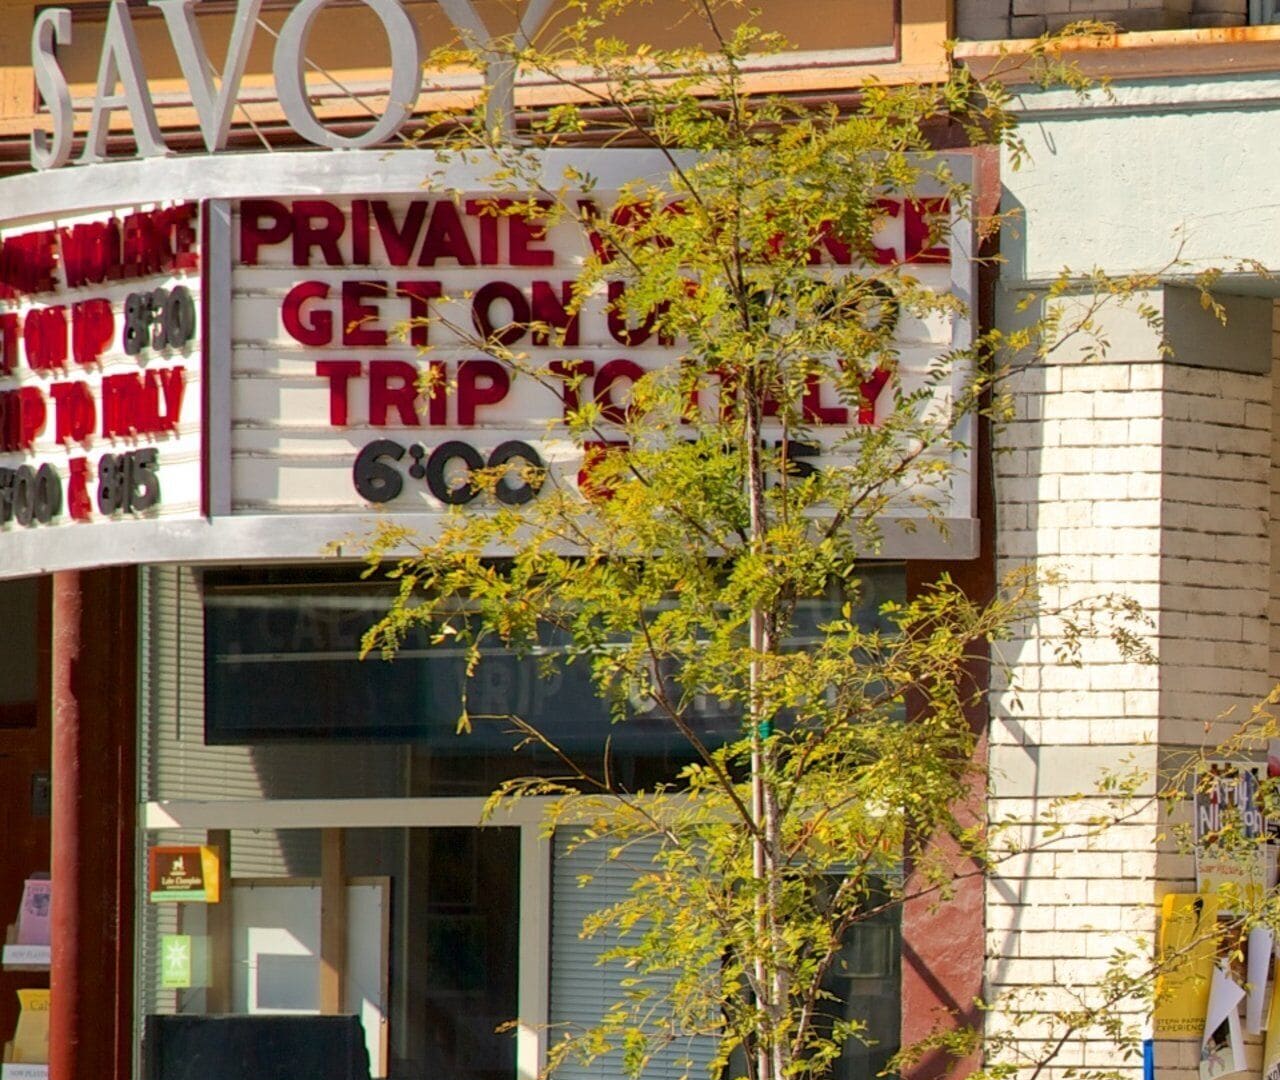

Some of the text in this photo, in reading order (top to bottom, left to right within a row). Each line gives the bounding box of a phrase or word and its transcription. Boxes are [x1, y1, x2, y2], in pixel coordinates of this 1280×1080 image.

[30, 0, 556, 170] SAVOY
[240, 200, 556, 267] PRIVATE
[283, 282, 440, 346] GET
[471, 281, 580, 347] ON
[315, 361, 511, 427] TRIP
[548, 359, 660, 427] TO
[353, 440, 545, 506] 6:00
